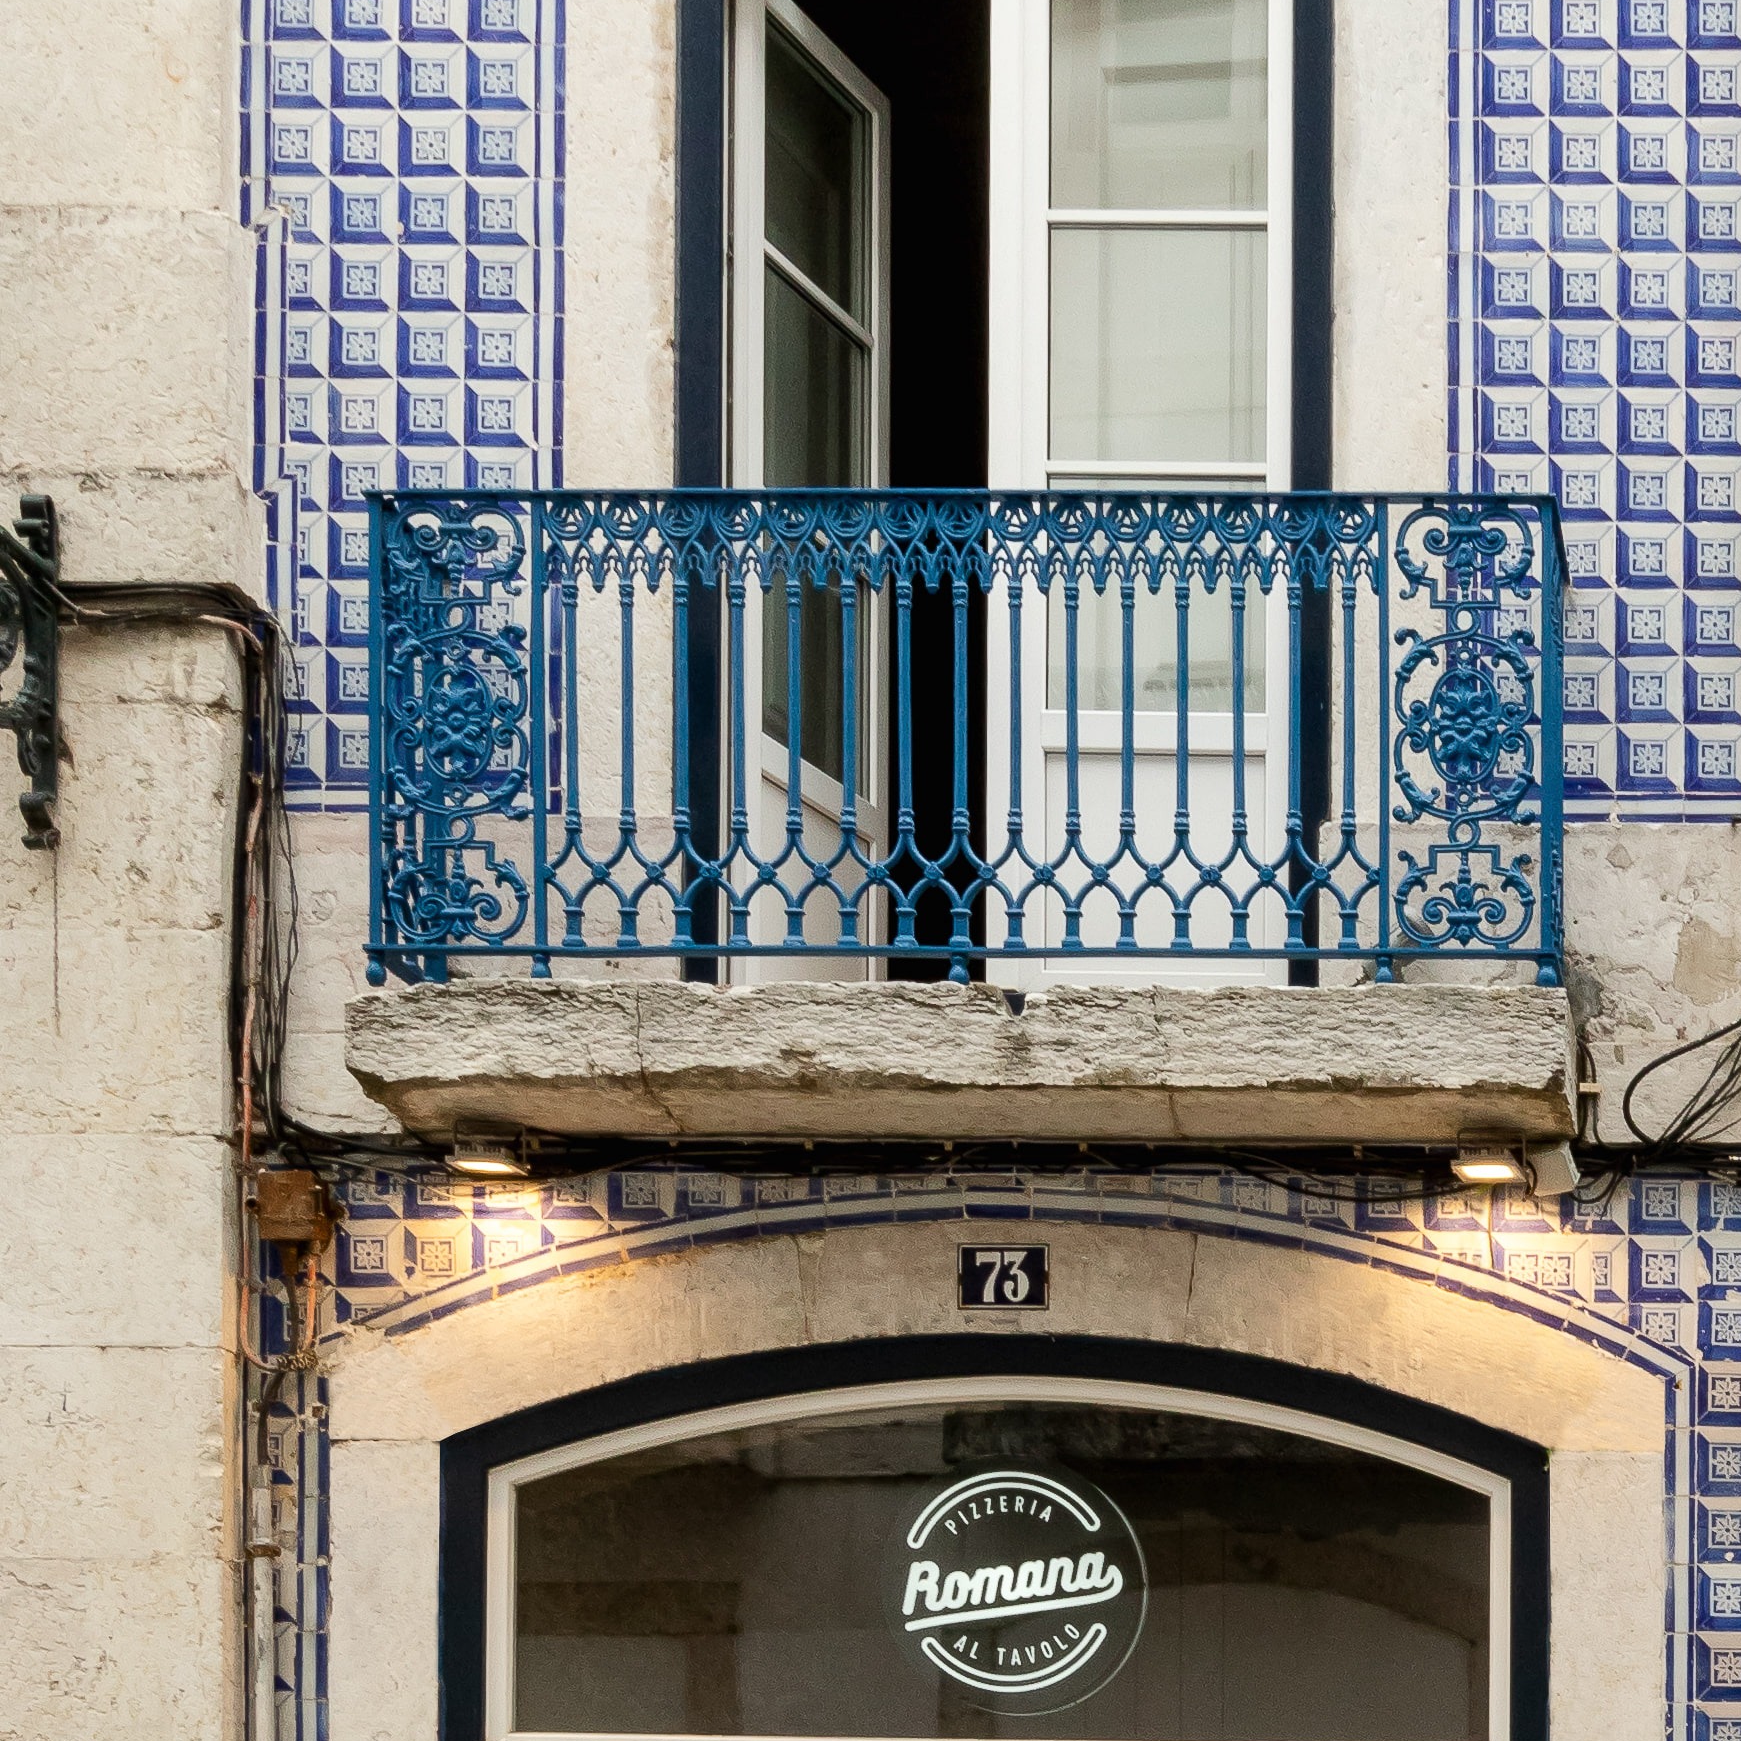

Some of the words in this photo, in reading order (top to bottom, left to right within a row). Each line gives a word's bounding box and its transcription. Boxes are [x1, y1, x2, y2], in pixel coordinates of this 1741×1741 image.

[975, 1251, 1030, 1303] 73
[944, 1495, 1053, 1535] PIZZERIA
[902, 1552, 1123, 1617] Romana
[953, 1635, 978, 1660] AL
[996, 1623, 1081, 1667] TAVOLO
